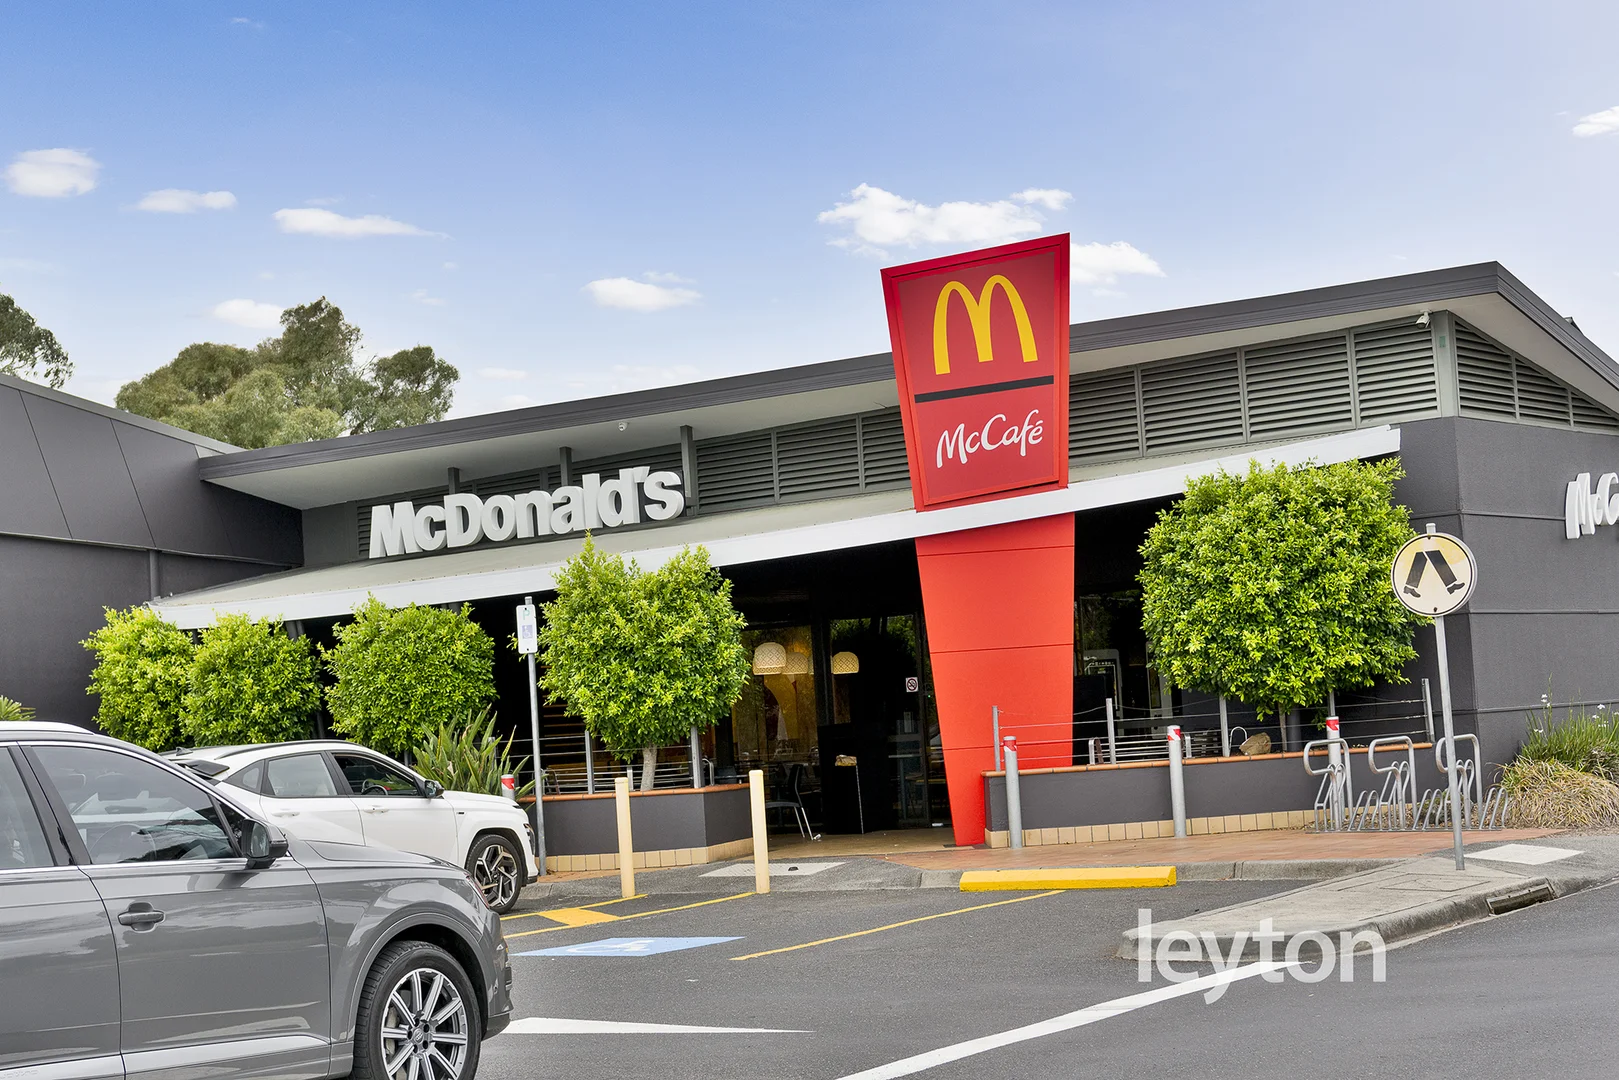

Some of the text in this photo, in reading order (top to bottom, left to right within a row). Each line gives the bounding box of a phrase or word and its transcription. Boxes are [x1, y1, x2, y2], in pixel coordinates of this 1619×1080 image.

[936, 409, 1044, 469] McCafé
[368, 466, 686, 559] McDonald's
[1565, 472, 1619, 540] McC
